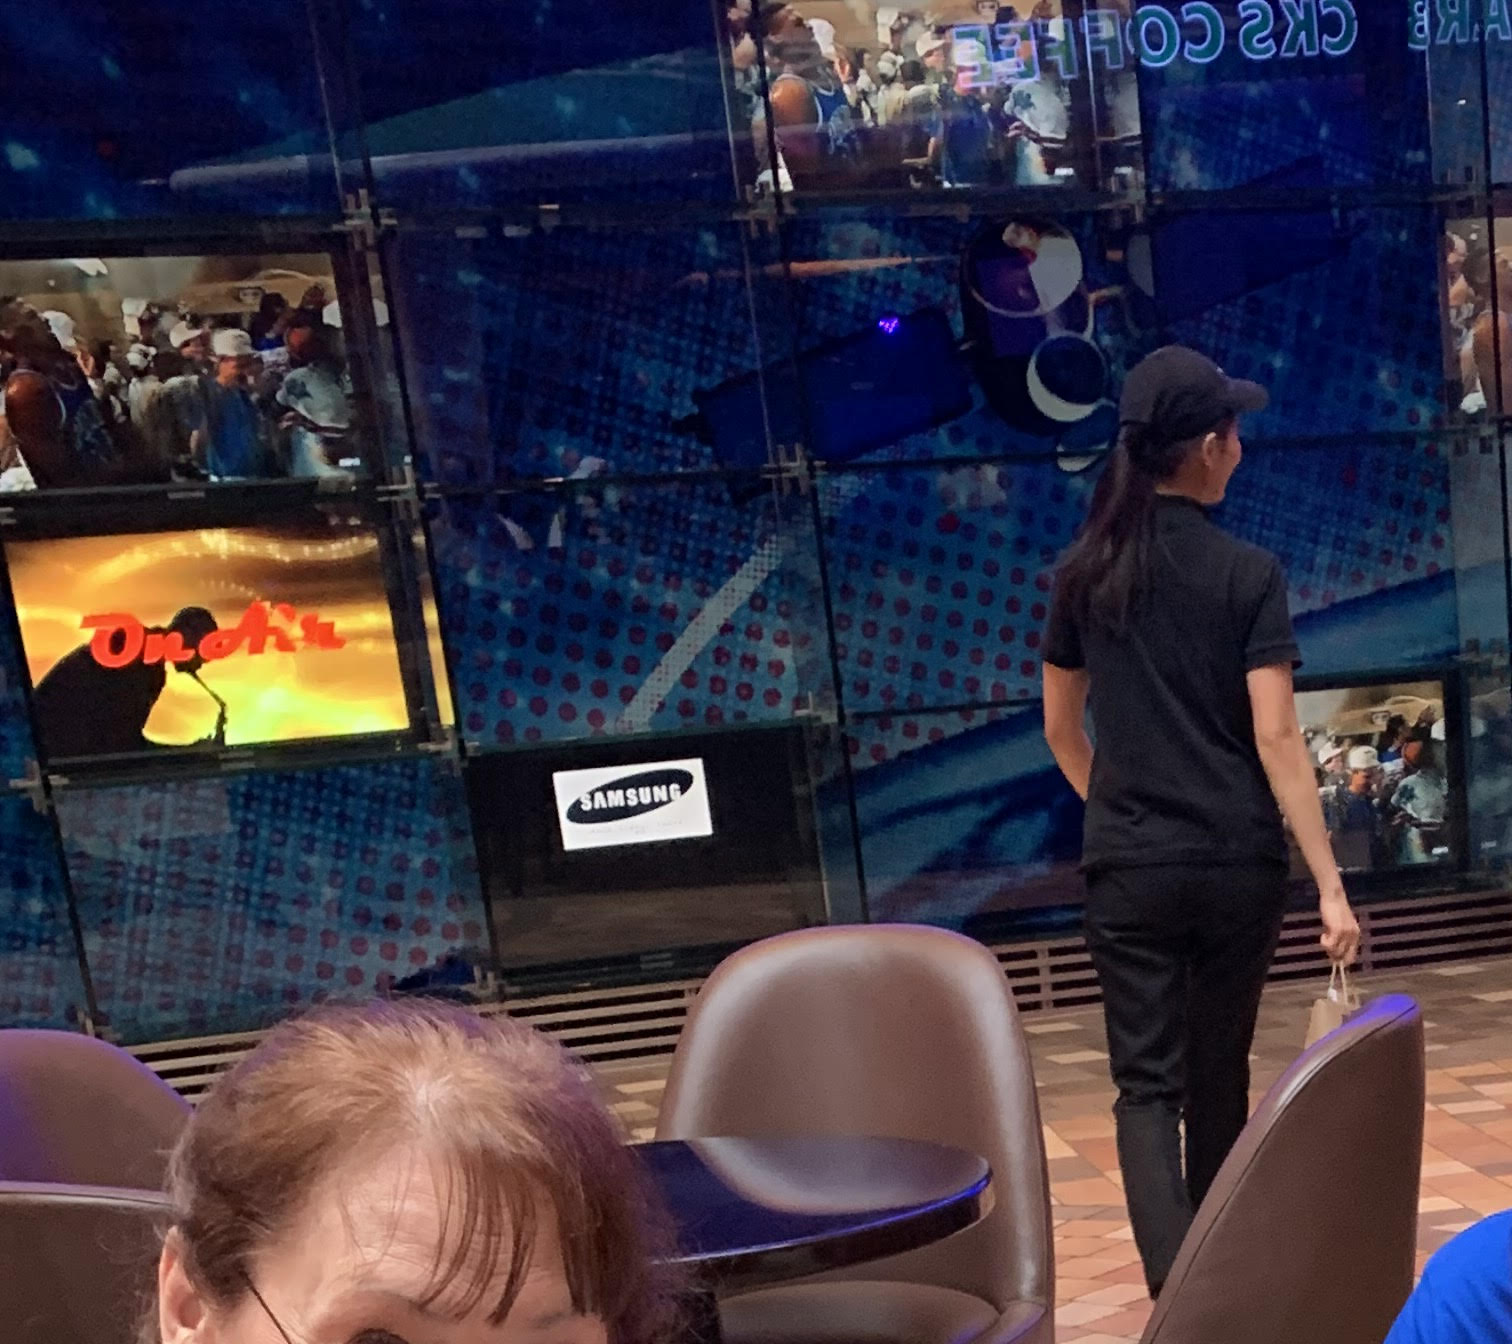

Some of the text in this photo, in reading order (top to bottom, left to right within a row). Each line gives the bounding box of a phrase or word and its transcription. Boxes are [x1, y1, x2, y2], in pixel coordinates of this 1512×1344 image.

[80, 601, 346, 668] On Air
[580, 783, 682, 811] SAMSUNG
